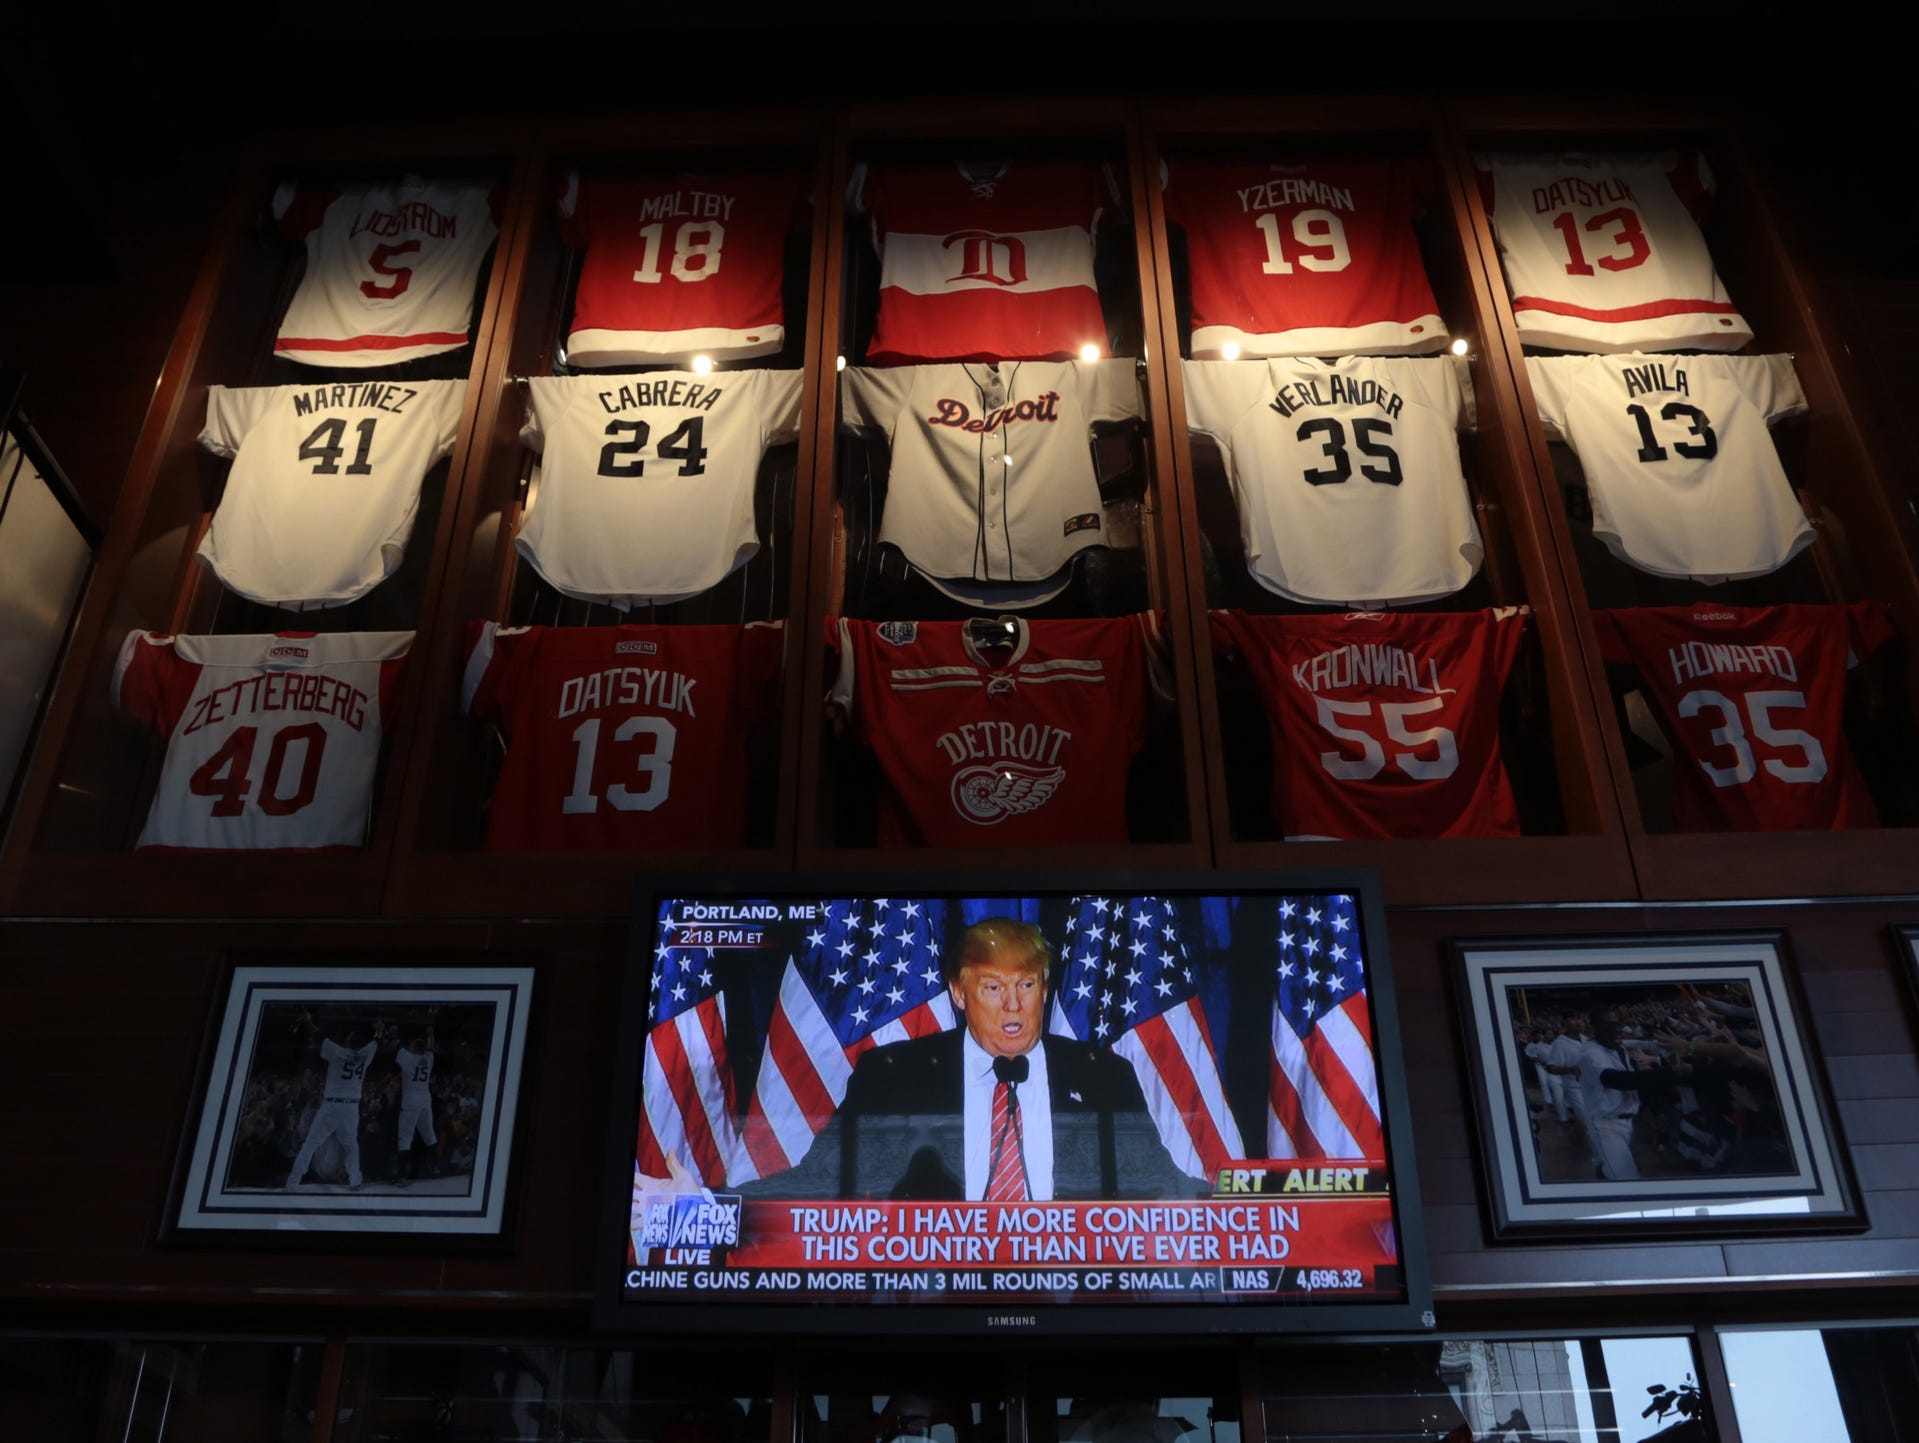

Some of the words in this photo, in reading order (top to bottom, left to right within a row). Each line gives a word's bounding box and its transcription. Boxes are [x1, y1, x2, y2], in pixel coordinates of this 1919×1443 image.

[640, 190, 736, 222] MALTBY
[1236, 178, 1355, 213] YZERMAN
[633, 220, 725, 284] 18
[1255, 208, 1352, 275] 19
[1553, 207, 1651, 276] 13
[360, 240, 421, 299] 5
[294, 383, 417, 417] MARTINEZ
[598, 379, 723, 413] CABRERA
[1269, 374, 1404, 420] VERLANDER
[1622, 363, 1689, 398] AVILA
[928, 391, 1060, 434] Detroit
[1626, 402, 1718, 463] 13
[298, 417, 377, 475] 41
[597, 416, 708, 478] 24
[1296, 417, 1404, 487] 35
[1293, 643, 1456, 694] KRONWALL
[1668, 641, 1798, 685] HOWARD
[183, 671, 367, 736] ZETTERBERG
[557, 667, 696, 719] DATSYUK
[936, 721, 1072, 765] DETROIT
[1312, 694, 1460, 780] 55
[1678, 690, 1828, 787] 35
[189, 722, 327, 817] 40
[562, 716, 677, 814] 13
[682, 906, 783, 921] PORTLAND,
[788, 906, 816, 919] ME
[680, 931, 713, 944] 2:18
[717, 931, 743, 943] PM
[747, 933, 763, 943] ET
[1282, 1168, 1369, 1192] ALERT
[681, 1223, 737, 1246] NEWS
[697, 1203, 738, 1225] FOX
[790, 1208, 888, 1234] TRUMP:
[898, 1208, 905, 1232] I
[914, 1208, 988, 1233] HAVE
[997, 1207, 1077, 1233] MORE
[1085, 1206, 1261, 1233] CONFIDENCE
[1269, 1206, 1300, 1231] IN
[665, 1248, 711, 1266] LIVE
[802, 1236, 859, 1261] THIS
[867, 1236, 1001, 1262] COUNTRY
[1010, 1236, 1086, 1262] THAN
[1095, 1236, 1146, 1261] I'VE
[1155, 1235, 1221, 1260] EVER
[1229, 1233, 1290, 1260] HAD
[625, 1270, 688, 1289] CHINE
[693, 1271, 751, 1290] GUNS
[756, 1273, 801, 1290] AND
[807, 1273, 866, 1290] MORE
[872, 1273, 928, 1290] THAN
[934, 1274, 946, 1289] 3
[953, 1273, 987, 1290] MIL
[993, 1272, 1078, 1290] ROUNDS
[1086, 1272, 1113, 1289] OF
[1119, 1272, 1184, 1289] SMALL
[1190, 1271, 1216, 1288] AR
[1232, 1270, 1270, 1289] NAS
[1296, 1269, 1363, 1292] 4,696.32
[987, 1315, 1036, 1326] SAMSUNG
